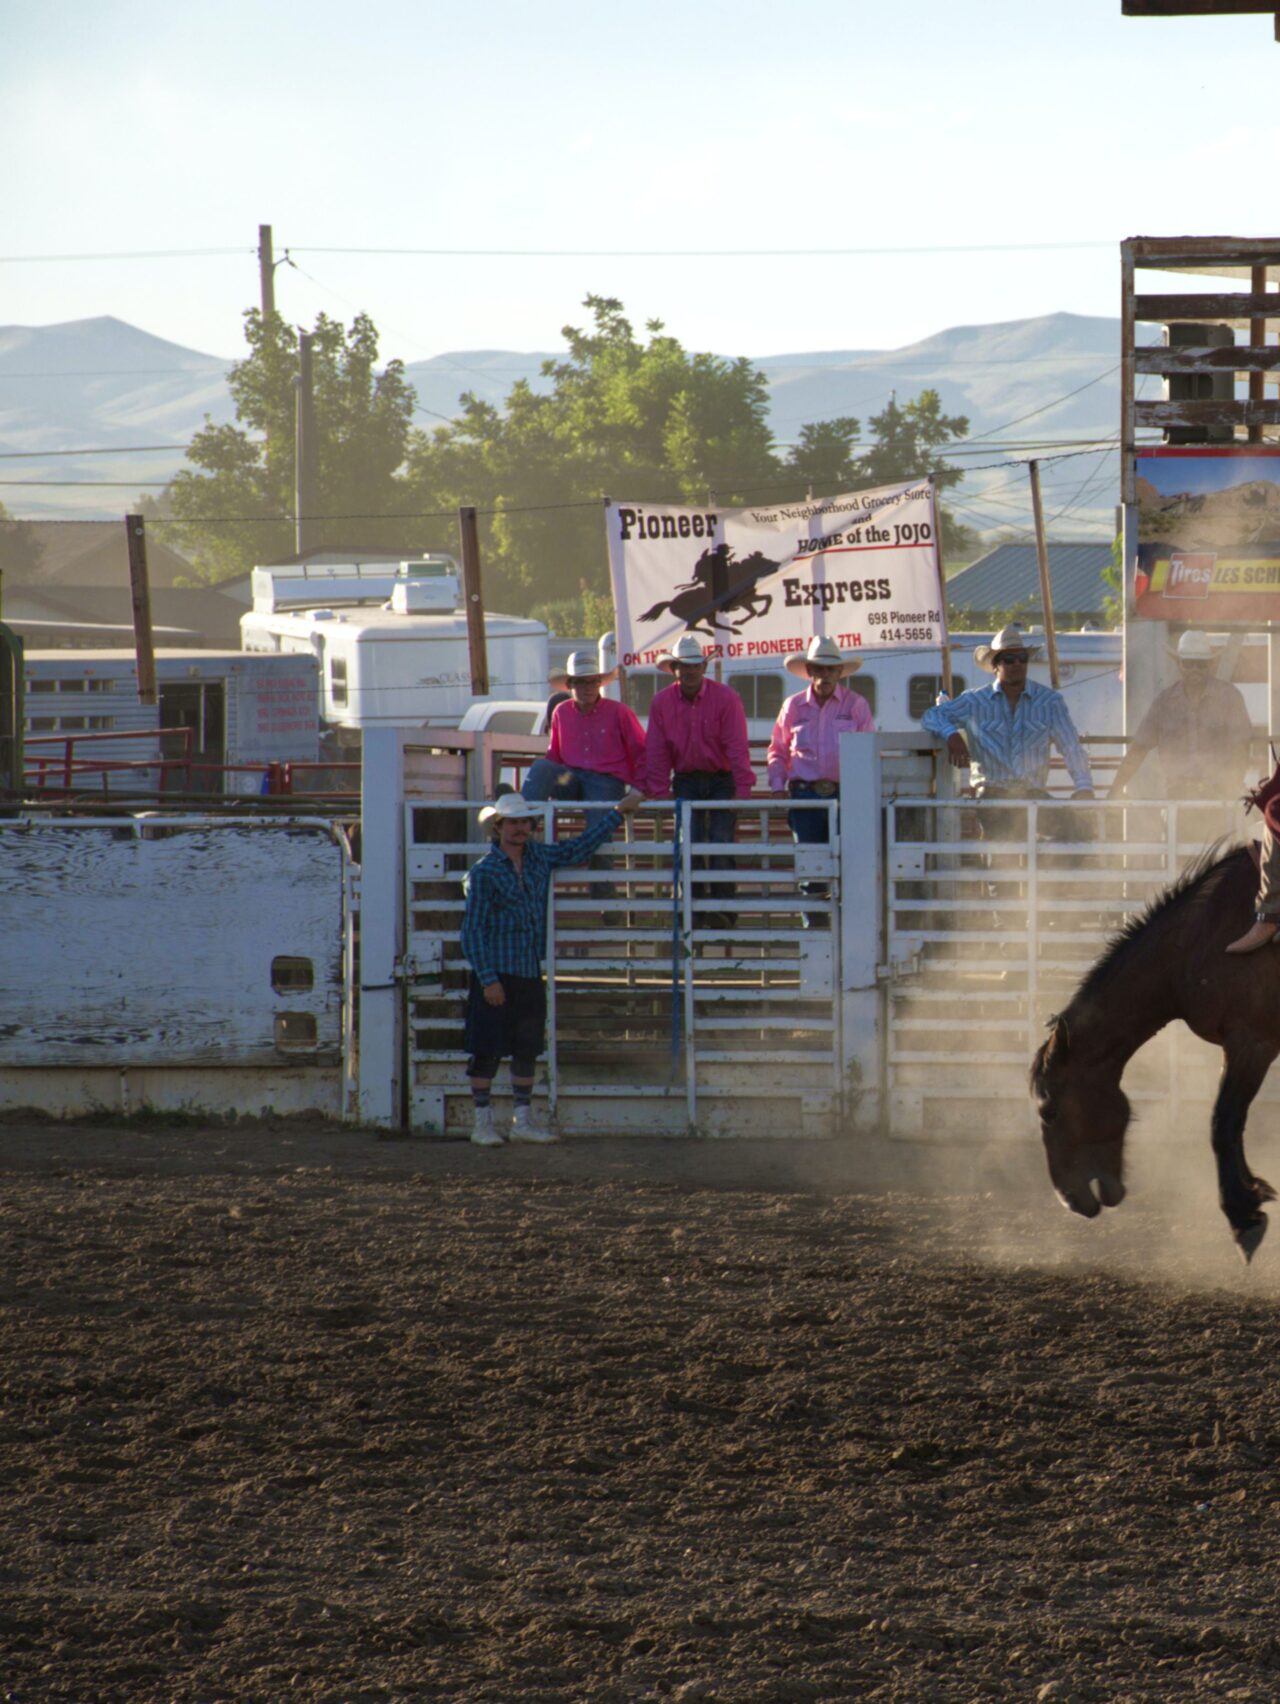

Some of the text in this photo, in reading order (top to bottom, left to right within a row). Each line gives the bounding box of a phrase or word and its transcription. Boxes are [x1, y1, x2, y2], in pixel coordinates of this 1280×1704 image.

[751, 512, 779, 524] Your
[780, 498, 860, 521] Neighborhood
[861, 491, 902, 510] Grocery
[851, 513, 873, 525] and
[618, 508, 718, 540] Pioneer
[797, 523, 931, 553] HOME of the JOJO
[1171, 560, 1212, 586] Tires
[1214, 567, 1240, 584] LES
[782, 577, 892, 611] Express
[867, 610, 941, 626] 698 Pioneer Rd
[879, 627, 933, 642] 414-5656
[623, 652, 641, 666] ON
[726, 643, 742, 657] OF
[747, 637, 804, 656] PIONEER
[837, 633, 862, 647] 7TH
